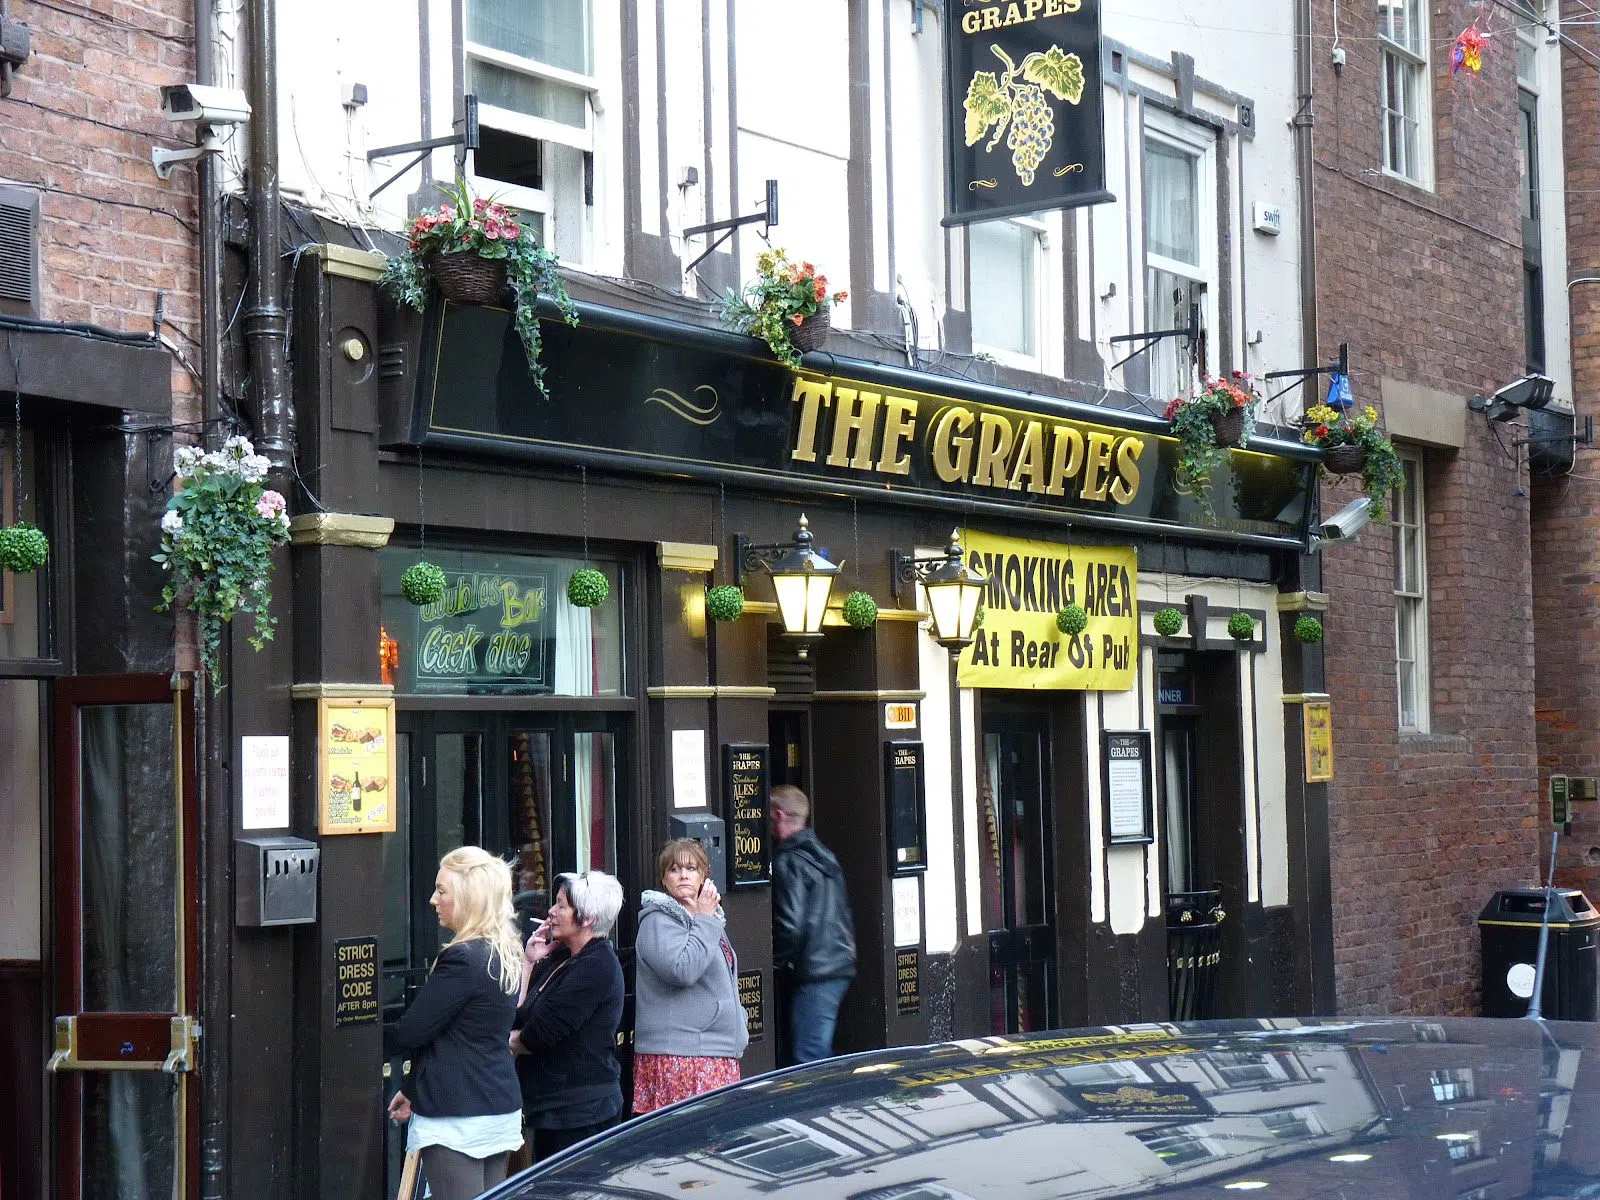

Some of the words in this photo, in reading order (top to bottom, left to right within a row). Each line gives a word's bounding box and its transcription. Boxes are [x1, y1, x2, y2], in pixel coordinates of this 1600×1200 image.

[961, 0, 1082, 34] GRAPES
[792, 377, 919, 475] THE
[932, 406, 1144, 505] GRAPES
[1084, 562, 1133, 617] AREA
[419, 624, 484, 673] Cask
[485, 628, 532, 674] ales
[971, 628, 1000, 667] At
[1010, 630, 1060, 668] Rear
[1068, 633, 1094, 669] Of
[1102, 634, 1130, 670] Pub
[1111, 747, 1139, 758] GRAPES
[894, 756, 916, 765] RAPES
[735, 808, 762, 819] AGERS
[735, 835, 760, 855] FOOD
[339, 944, 375, 961] STRICT
[898, 953, 917, 966] STRICT
[340, 962, 375, 980] DRESS
[898, 967, 917, 980] DRESS
[343, 981, 372, 998] CODE
[738, 976, 760, 990] STRICT
[900, 982, 917, 994] CODE
[337, 1001, 360, 1012] AFTER
[362, 1000, 377, 1010] 8pm
[746, 1007, 760, 1018] ODE
